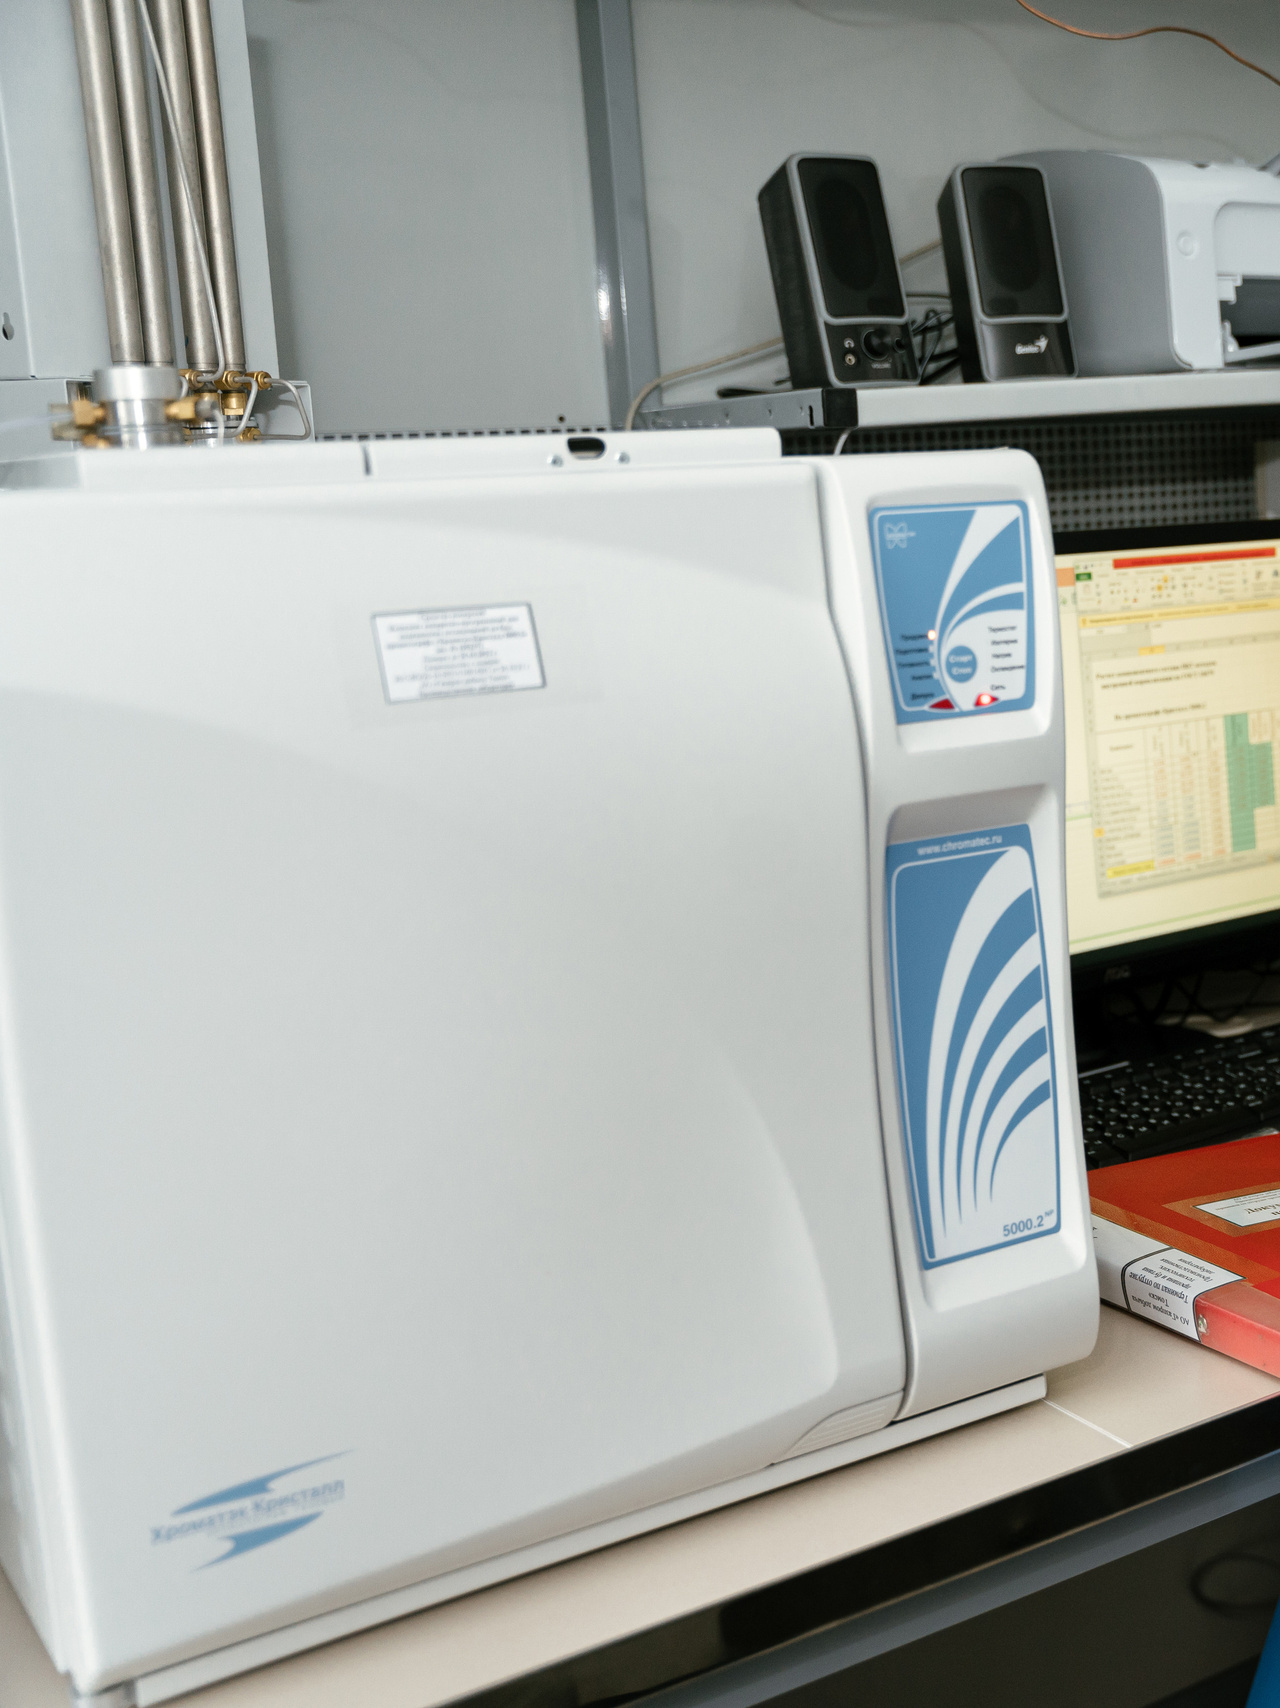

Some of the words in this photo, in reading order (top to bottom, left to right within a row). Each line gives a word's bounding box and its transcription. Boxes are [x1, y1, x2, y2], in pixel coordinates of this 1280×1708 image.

[951, 667, 973, 675] Стоп
[917, 835, 1003, 856] www.chromatec.ru
[1003, 1215, 1044, 1237] 5000.2
[1129, 1271, 1153, 1287] отгрузке
[1152, 1281, 1161, 1290] по
